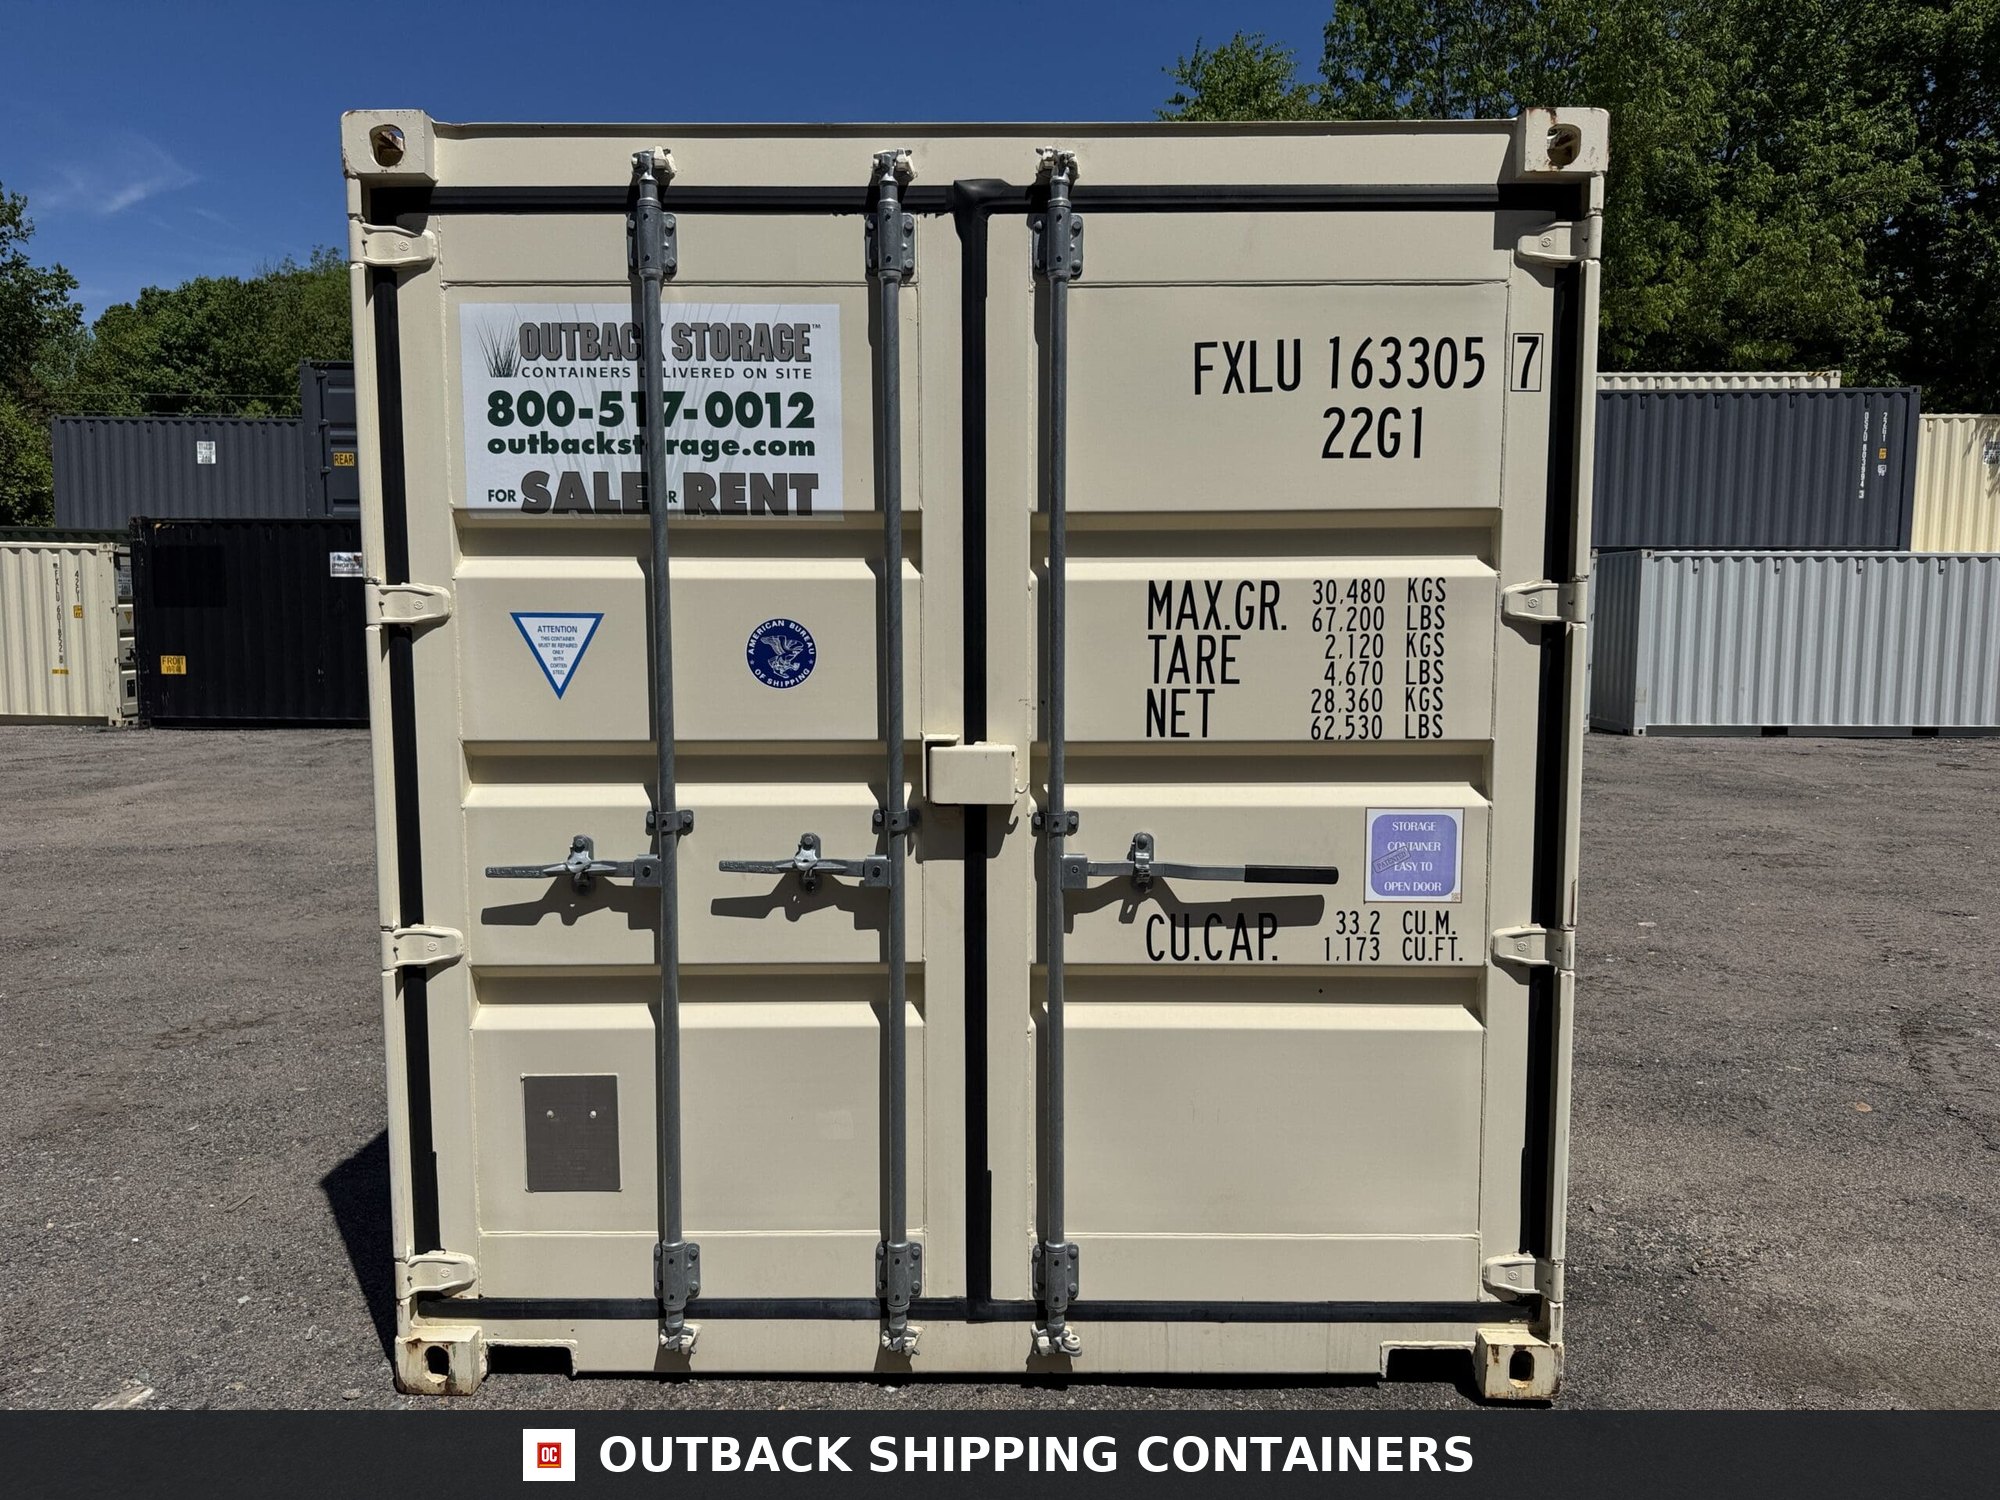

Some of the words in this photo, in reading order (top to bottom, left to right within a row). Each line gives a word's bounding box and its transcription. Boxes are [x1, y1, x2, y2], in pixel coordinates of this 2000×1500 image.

[671, 322, 812, 362] STORAGE
[521, 366, 631, 378] CONTAINERS
[743, 368, 767, 379] ON
[776, 368, 812, 379] SITE
[1194, 338, 1301, 396] FXLU
[1329, 335, 1485, 390] 163305
[1516, 336, 1539, 389] 7
[487, 390, 815, 429] 800-517-0012
[487, 431, 815, 463] outbackstrage.com
[1321, 406, 1423, 459] 22G1
[334, 454, 354, 465] REAR
[488, 489, 517, 503] FOR
[520, 470, 650, 514] SALE
[683, 472, 819, 516] RENT
[1147, 579, 1287, 631] MAX.GR.
[1312, 578, 1386, 605] 30,480
[1407, 577, 1447, 603] KGS
[1312, 605, 1385, 633] 67,200
[1406, 604, 1445, 631] LBS
[748, 620, 785, 655] AMERICAN
[789, 622, 815, 655] BUREAU
[1147, 634, 1242, 685] TARE
[1324, 633, 1384, 660] 2,120
[1405, 632, 1445, 658] KGS
[1323, 660, 1384, 687] 4,670
[1405, 659, 1444, 686] LBS
[754, 669, 767, 680] OF
[766, 668, 810, 687] SHIPPING
[1146, 688, 1216, 738] NET
[1310, 687, 1383, 714] 28,360
[1405, 686, 1444, 713] KGS
[1310, 714, 1383, 740] 62,530
[1404, 713, 1443, 739] LBS
[1392, 821, 1437, 831] STORAGE
[1387, 841, 1441, 851] CONTAINER
[1394, 862, 1418, 871] EASY
[1420, 862, 1433, 871] TO
[1384, 881, 1411, 891] OPEN
[1413, 881, 1442, 891] DOOR
[1146, 912, 1279, 961] CU.CAP.
[1335, 910, 1381, 936] 33.2
[1402, 910, 1457, 935] CU.M.
[1324, 936, 1380, 962] 1,173
[1402, 936, 1464, 962] CU.FT.
